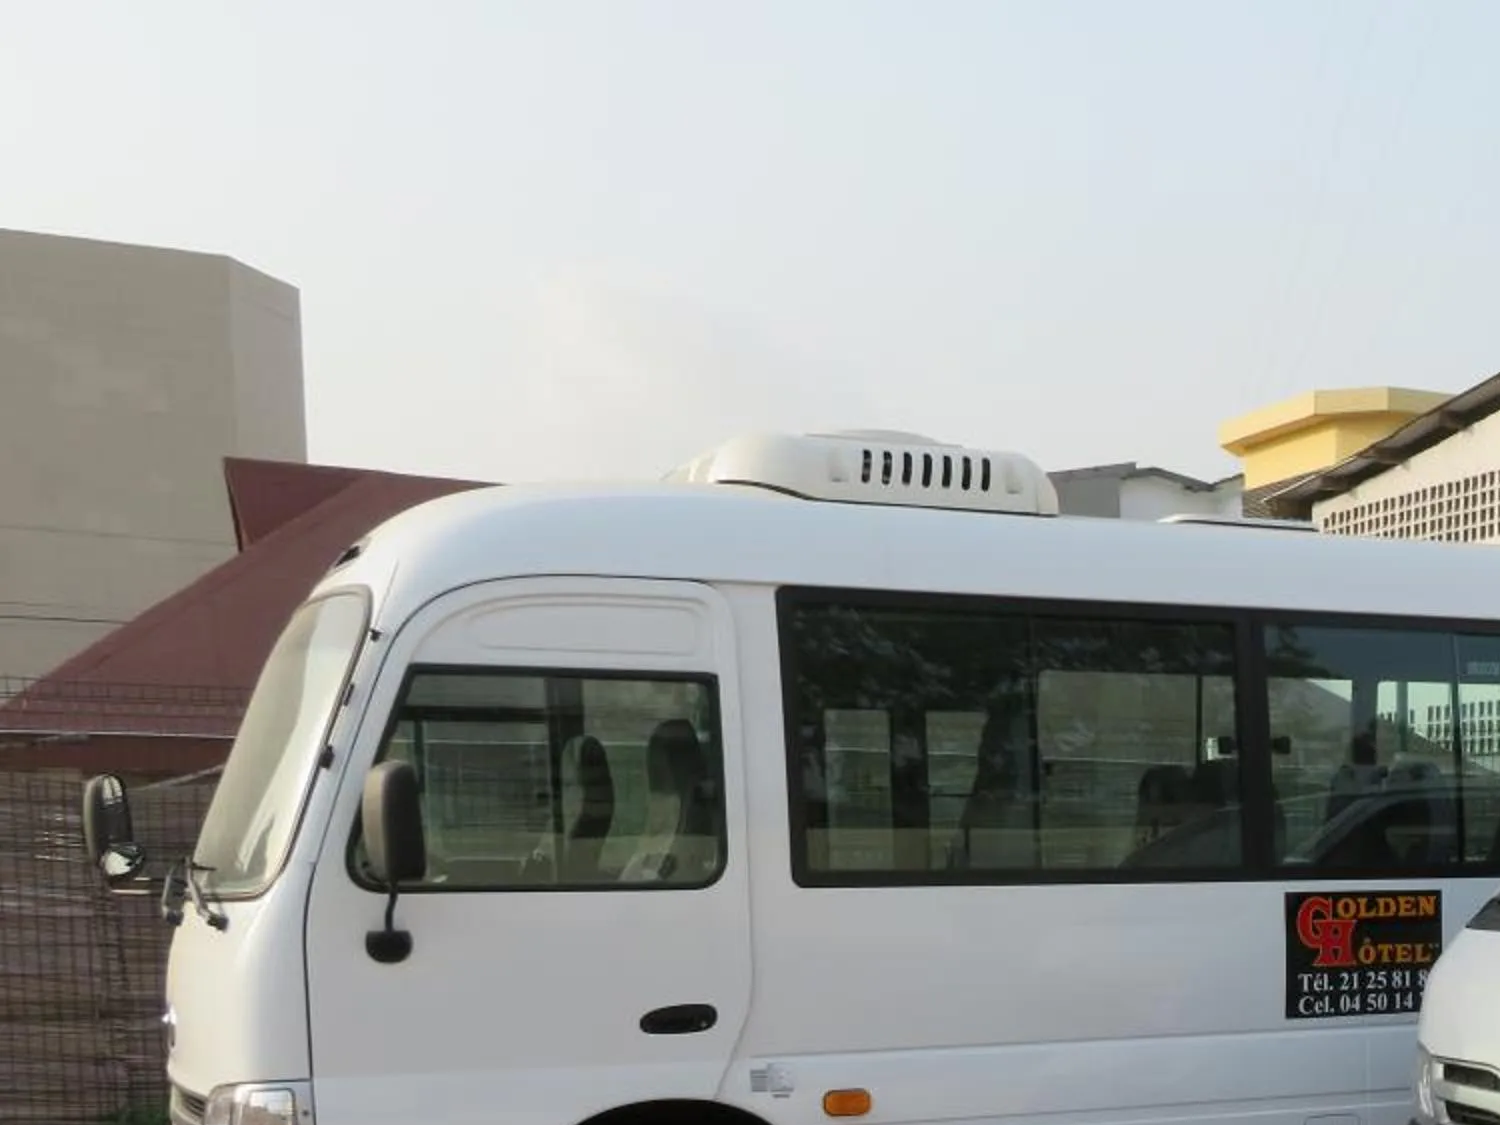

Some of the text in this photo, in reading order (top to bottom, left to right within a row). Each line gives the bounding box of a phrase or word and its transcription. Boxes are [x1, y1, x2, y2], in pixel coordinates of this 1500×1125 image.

[1296, 896, 1436, 949] GOLDEN
[1298, 972, 1334, 993] Tél.
[1339, 972, 1360, 991] 21
[1366, 971, 1387, 989] 25
[1392, 970, 1411, 988] 81
[1298, 996, 1335, 1014] Cel.
[1339, 994, 1361, 1012] 04
[1366, 993, 1388, 1011] 50
[1394, 991, 1413, 1009] 14
